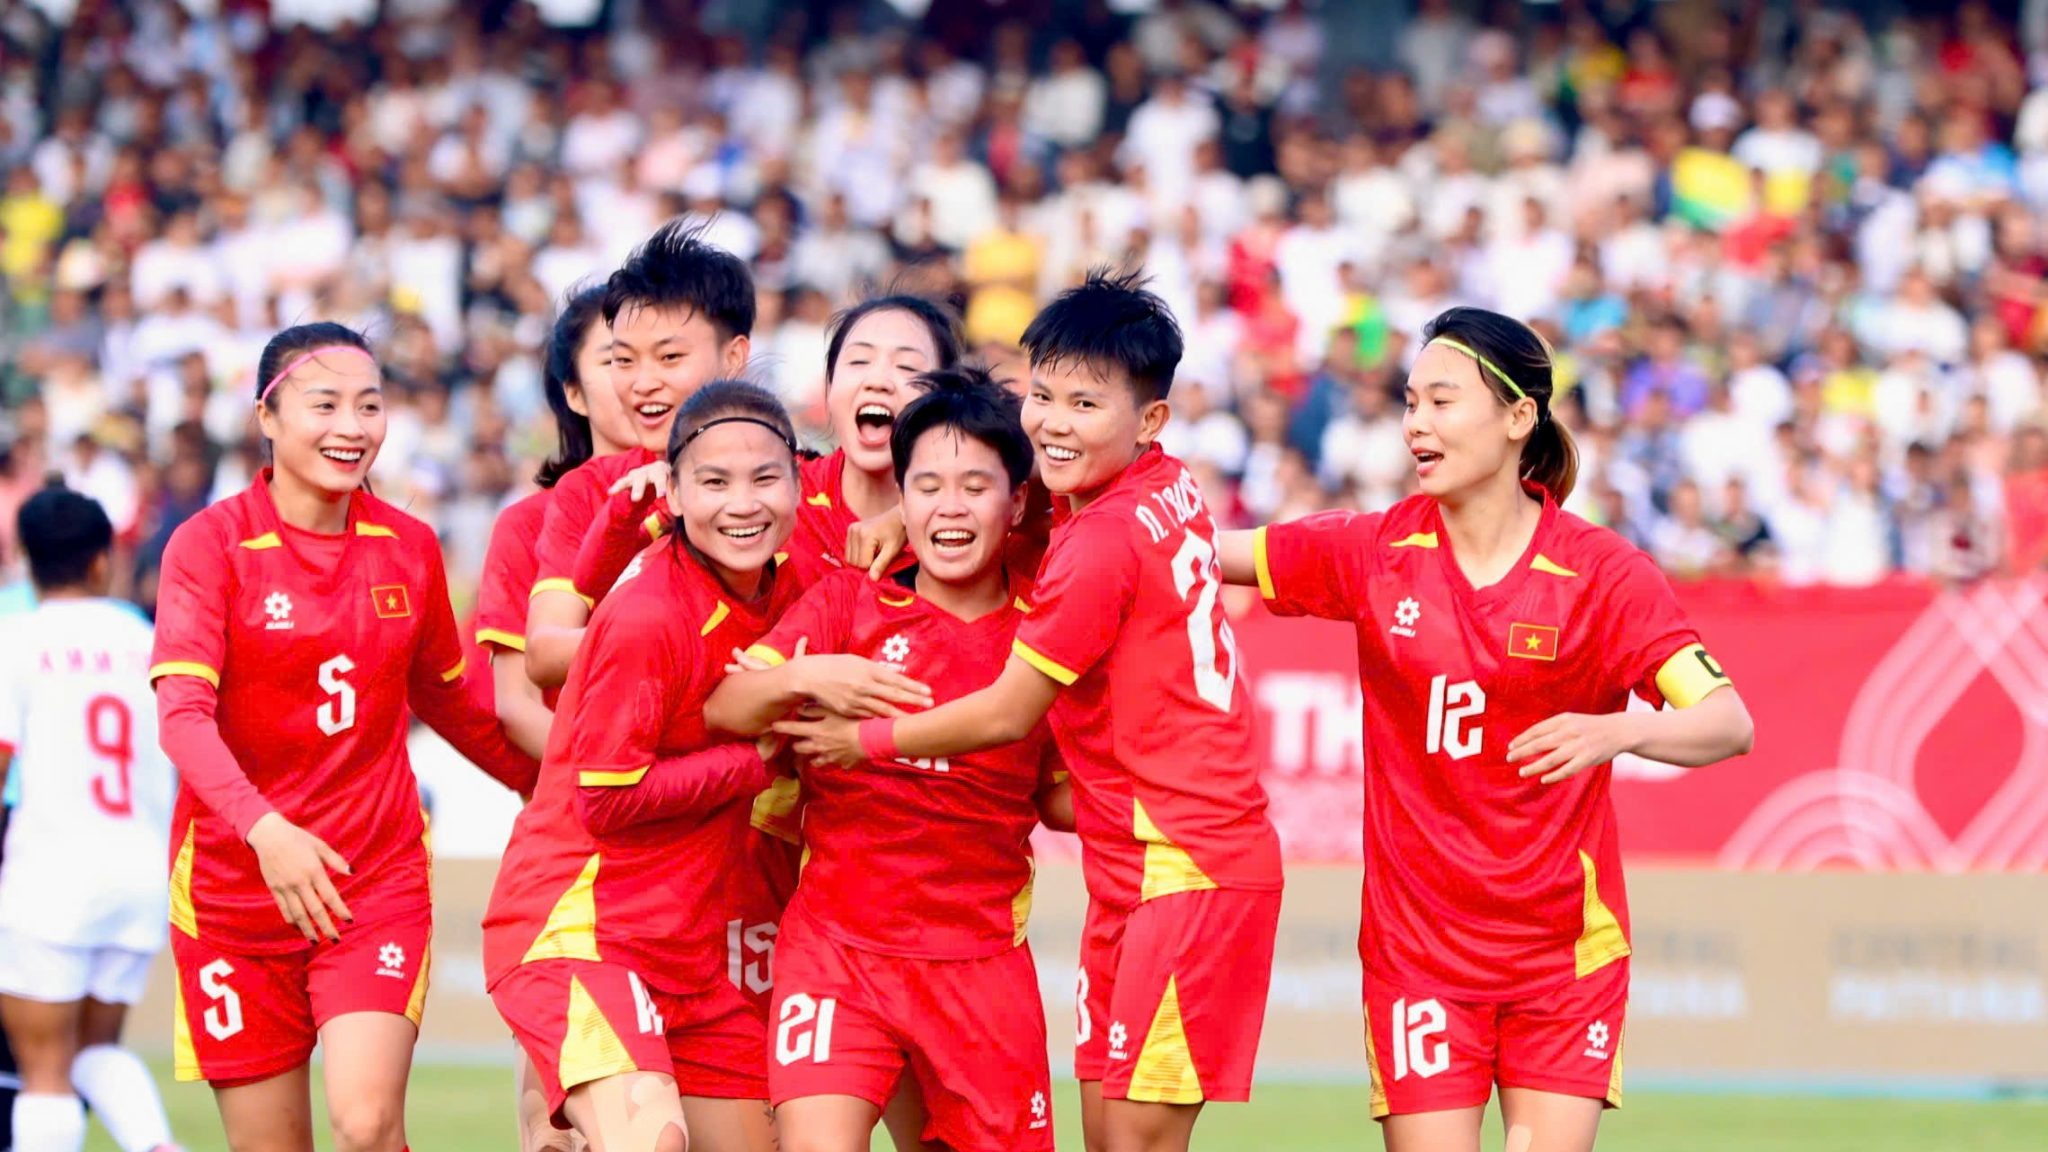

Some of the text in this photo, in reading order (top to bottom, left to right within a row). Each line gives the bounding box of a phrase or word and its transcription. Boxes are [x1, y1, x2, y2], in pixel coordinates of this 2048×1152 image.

[1170, 514, 1237, 713] 2
[317, 653, 356, 737] 5
[1426, 674, 1486, 760] 12
[85, 693, 134, 817] 9
[727, 918, 779, 994] 15
[200, 958, 244, 1042] 5
[776, 992, 837, 1066] 21
[1392, 997, 1450, 1081] 12
